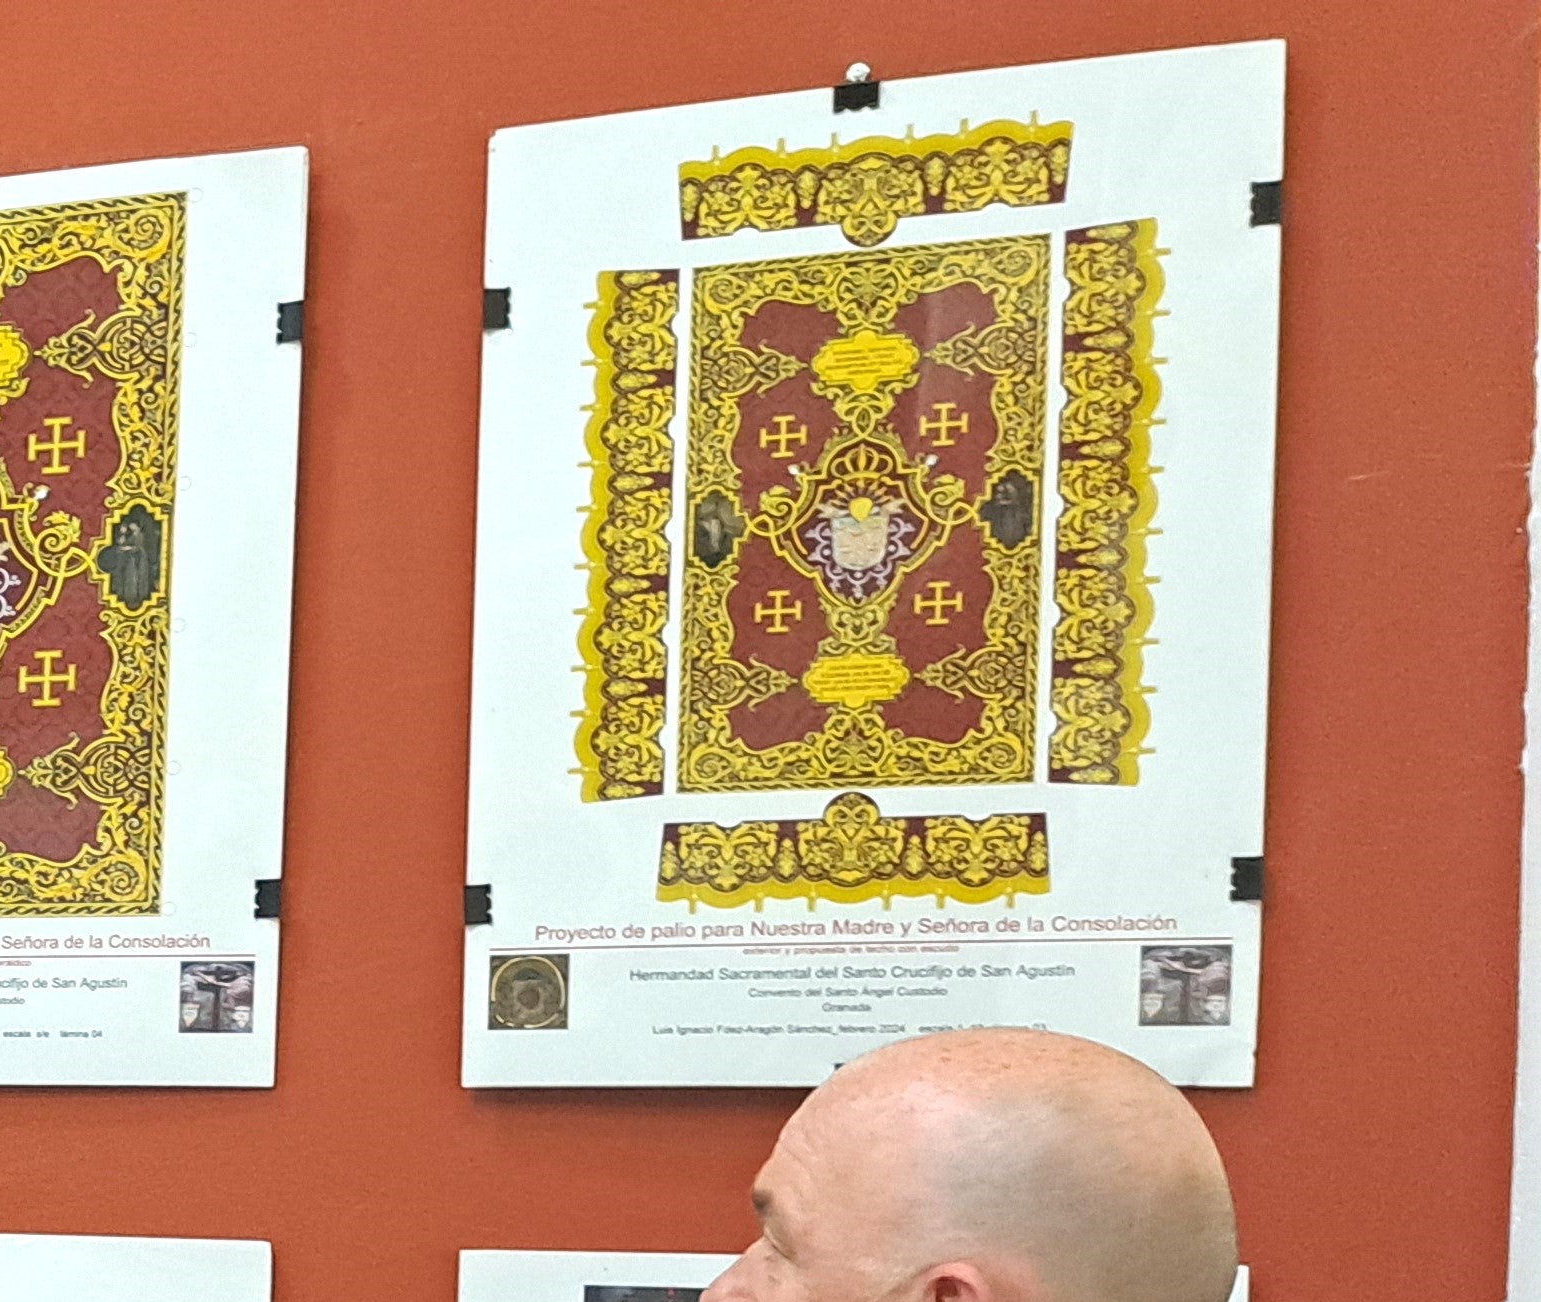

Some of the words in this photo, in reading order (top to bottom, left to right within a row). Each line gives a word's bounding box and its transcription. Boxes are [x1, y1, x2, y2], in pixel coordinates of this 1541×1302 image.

[535, 925, 617, 944] Proyecto
[621, 923, 646, 939] de
[650, 921, 696, 941] palio
[701, 924, 744, 940] para
[750, 920, 826, 936] Nuestra
[831, 918, 895, 935] Madre
[899, 922, 912, 938] y
[917, 917, 990, 934] Señora
[995, 916, 1021, 933] de
[1026, 916, 1045, 932] la
[1051, 914, 1177, 932] Consolación
[0, 935, 59, 949] Señora
[63, 935, 84, 949] de
[88, 934, 103, 949] la
[108, 933, 211, 949] Consolación
[629, 968, 714, 981] Hermandad
[718, 966, 812, 980] Sacramental
[814, 966, 838, 979] del
[842, 965, 887, 979] Santo
[890, 964, 953, 980] Crucifijo
[956, 965, 977, 978] de
[980, 964, 1012, 977] San
[1015, 964, 1075, 980] Agustín
[31, 977, 48, 988] de
[51, 976, 76, 988] San
[79, 977, 128, 991] Agustín
